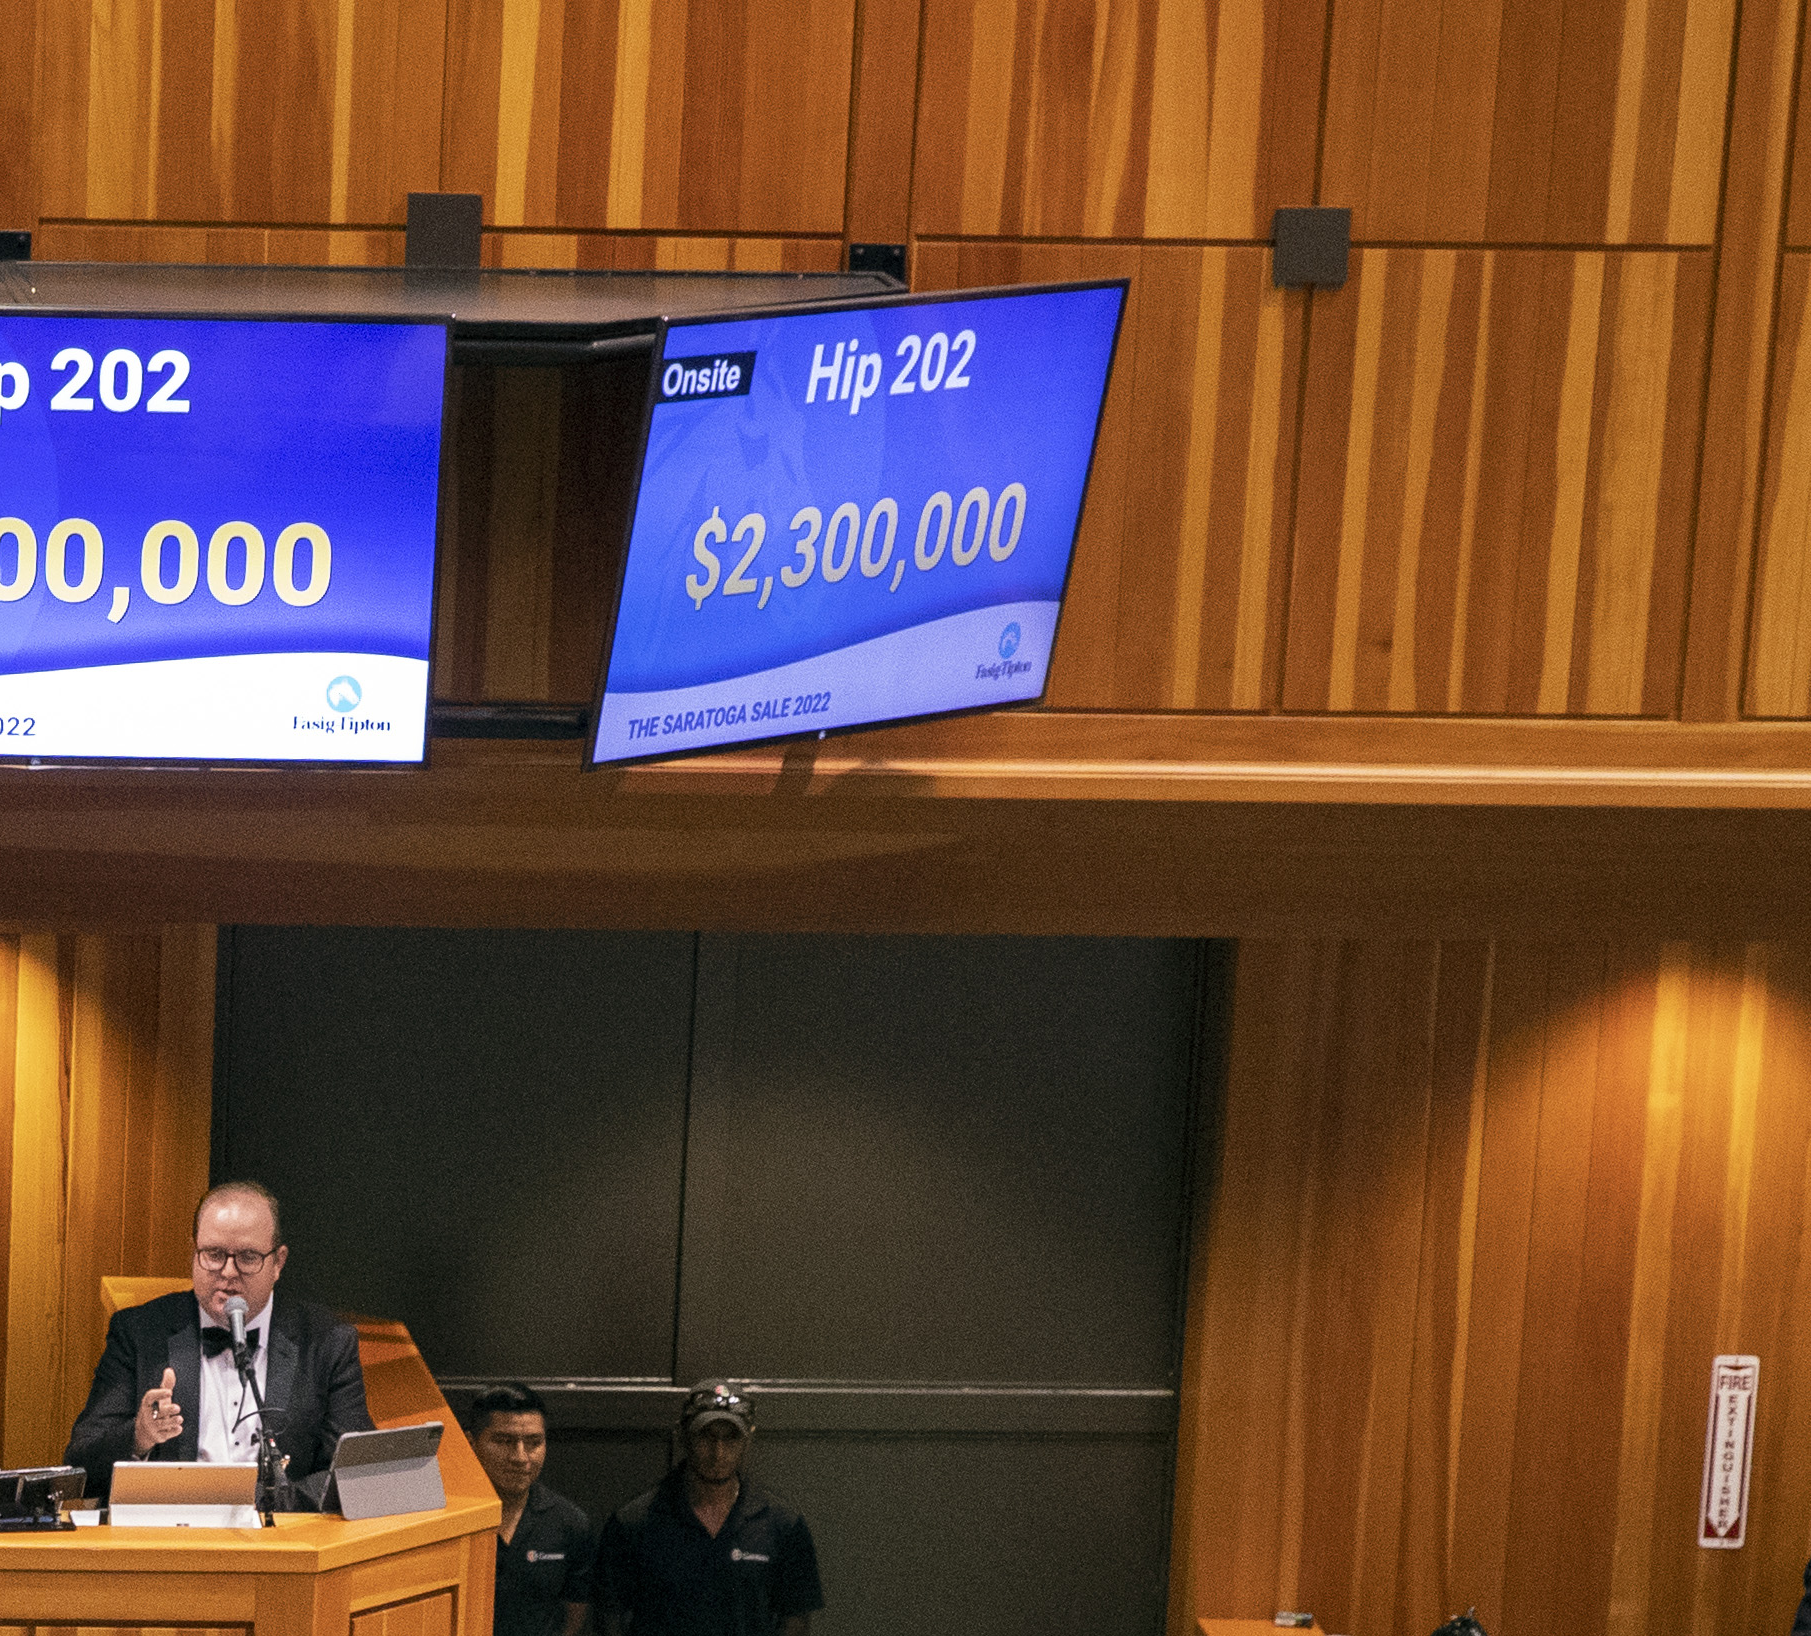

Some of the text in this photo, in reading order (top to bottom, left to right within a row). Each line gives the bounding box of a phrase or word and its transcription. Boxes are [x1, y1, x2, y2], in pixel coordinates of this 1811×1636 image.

[49, 348, 191, 414] 202
[663, 360, 741, 396] Onsite
[805, 329, 977, 415] Hip 202
[685, 482, 1027, 611] $2,300,000
[628, 691, 831, 740] THE SARATOGA SALE 2022
[1720, 1375, 1752, 1390] FIRE
